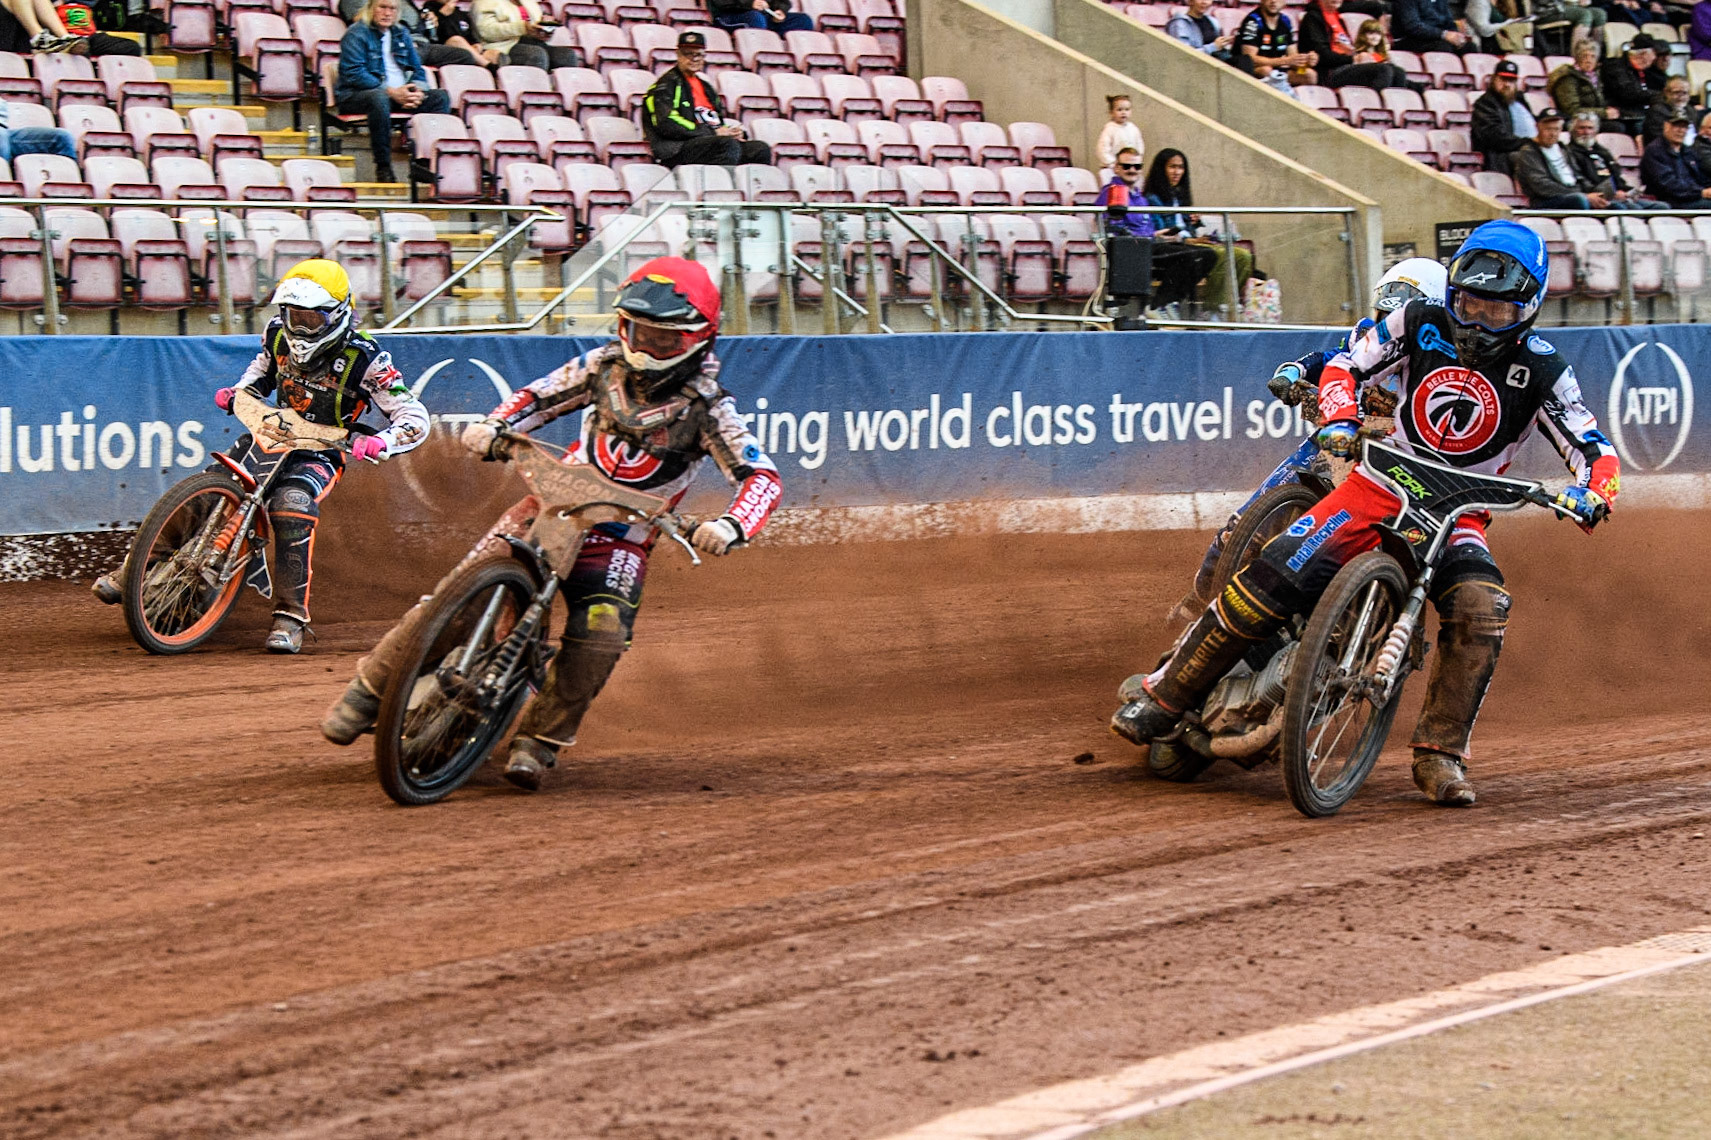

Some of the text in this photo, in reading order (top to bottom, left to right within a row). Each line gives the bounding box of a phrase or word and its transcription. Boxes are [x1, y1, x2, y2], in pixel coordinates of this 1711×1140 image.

[333, 358, 345, 373] 6
[1511, 368, 1526, 386] 4
[1426, 371, 1495, 416] BELLE VUE COLTS
[1622, 387, 1678, 425] ATPI
[0, 404, 206, 473] lutions
[843, 392, 973, 452] world
[985, 390, 1097, 448] class
[1109, 386, 1233, 443] travel
[1387, 465, 1433, 500] FORK
[1286, 509, 1351, 573] Metal Recycling
[1176, 627, 1228, 685] PENRITE
